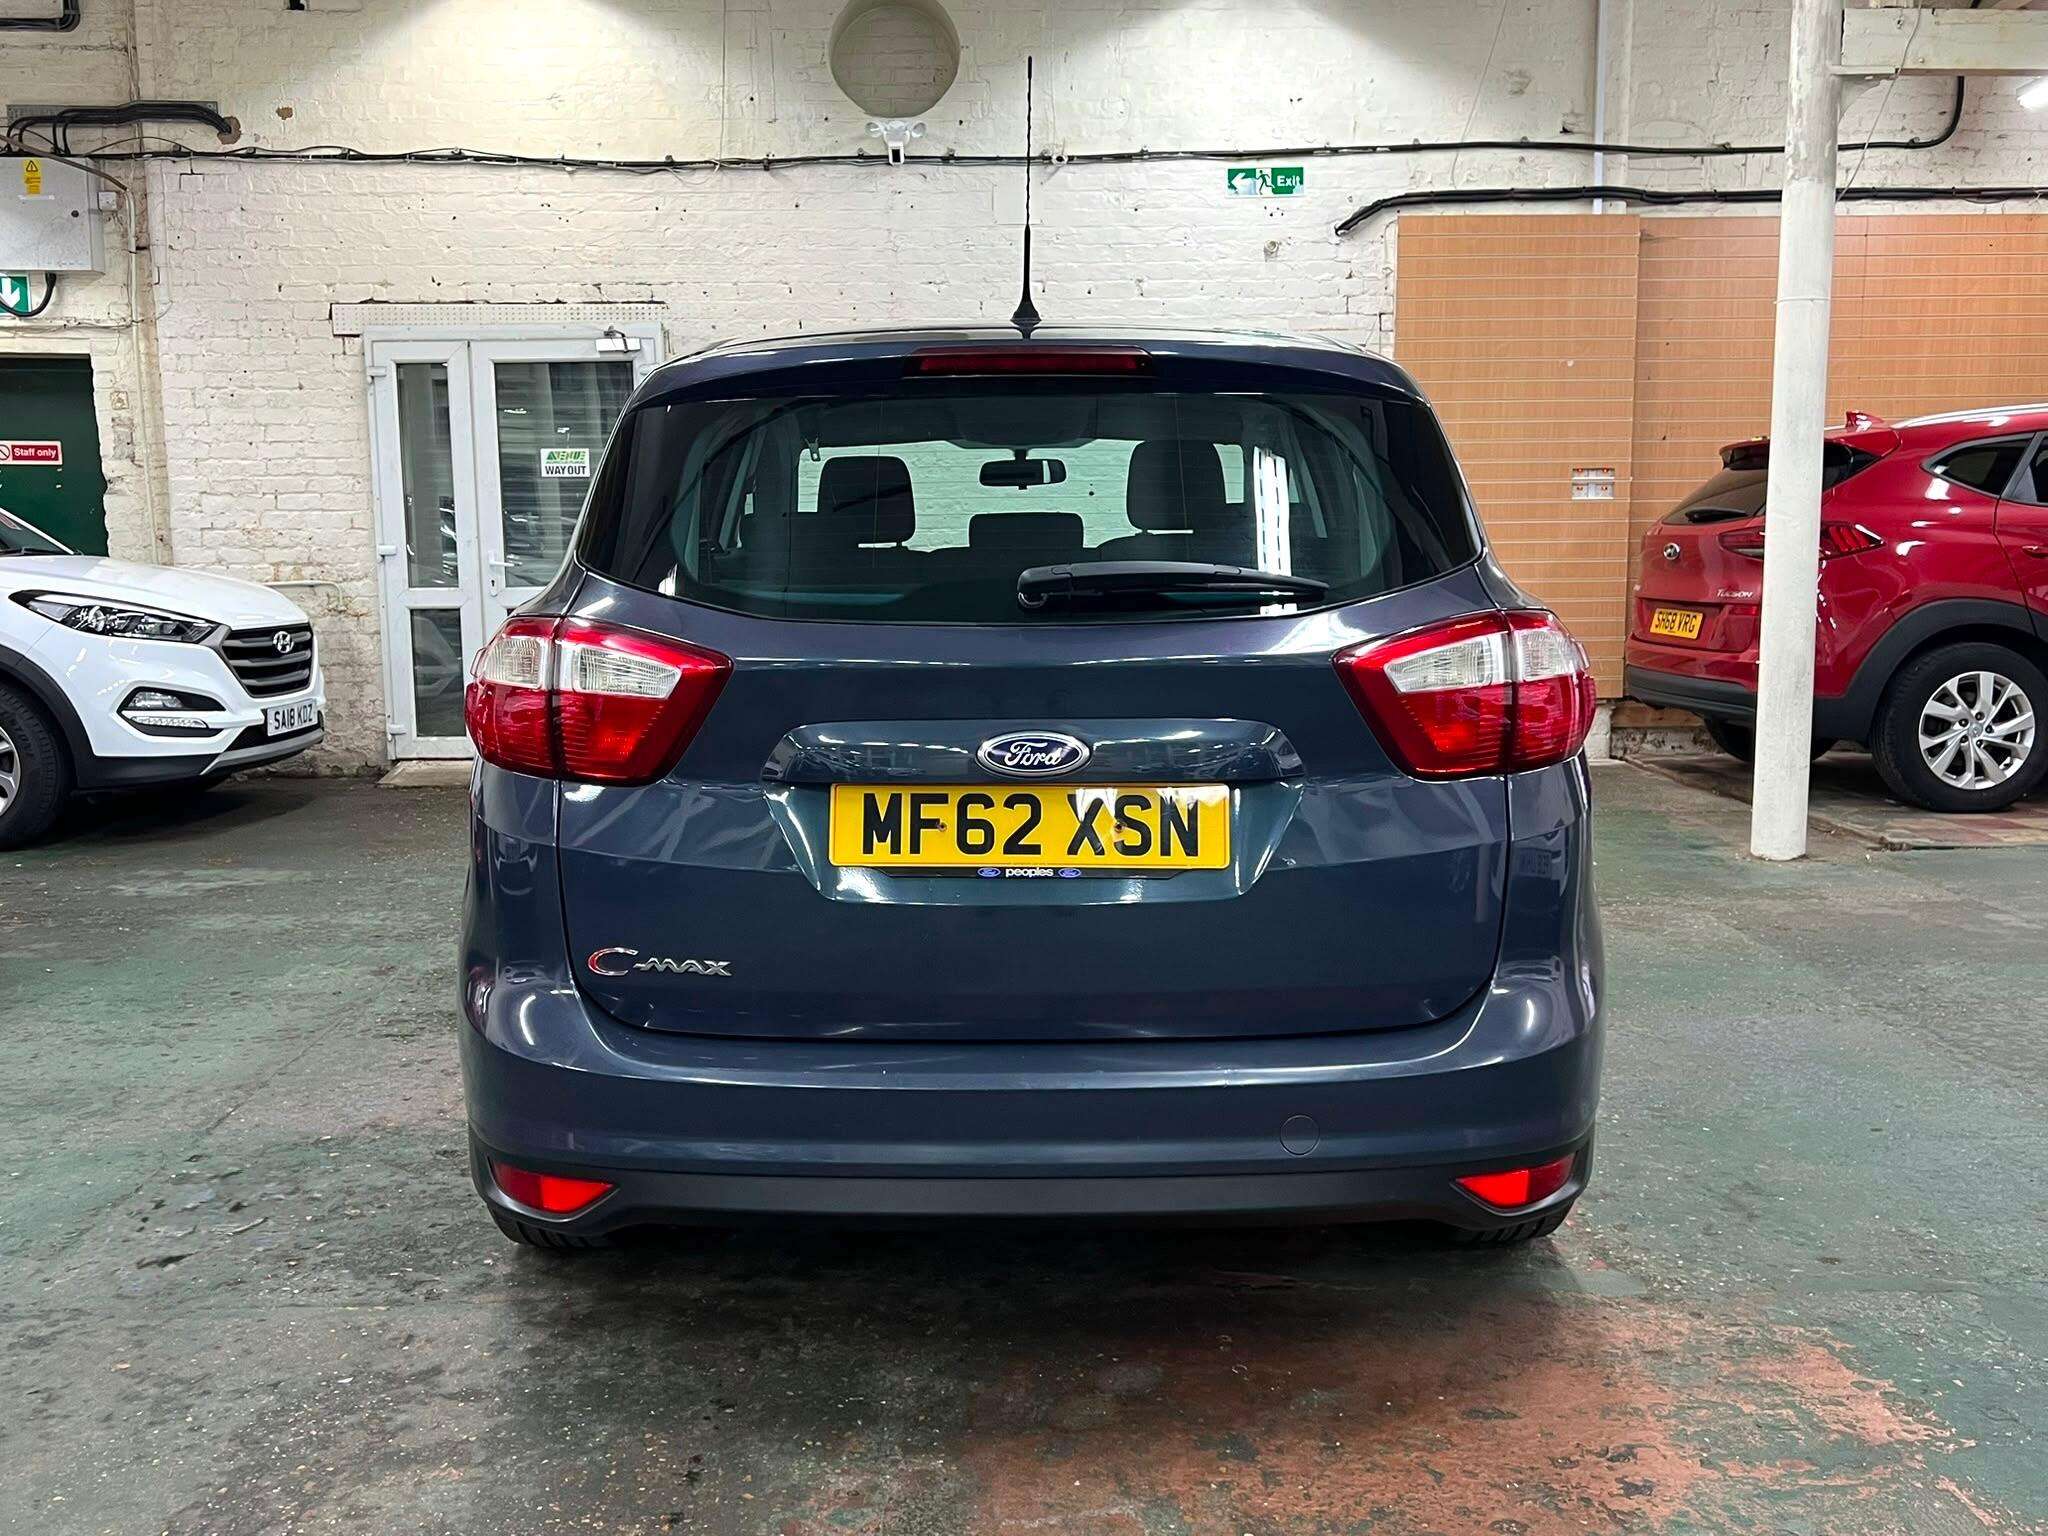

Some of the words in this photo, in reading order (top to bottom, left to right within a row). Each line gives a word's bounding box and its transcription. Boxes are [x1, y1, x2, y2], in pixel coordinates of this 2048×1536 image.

[1277, 175, 1300, 186] Exit
[13, 448, 35, 456] Staff
[36, 448, 56, 459] only
[545, 466, 566, 475] WAY
[567, 466, 586, 475] OUT
[274, 708, 295, 730] SA18
[297, 704, 313, 725] KDZ
[1004, 742, 1063, 766] Ford
[862, 793, 1042, 856] MF62
[1067, 794, 1199, 857] XSN
[1005, 867, 1054, 878] peoples
